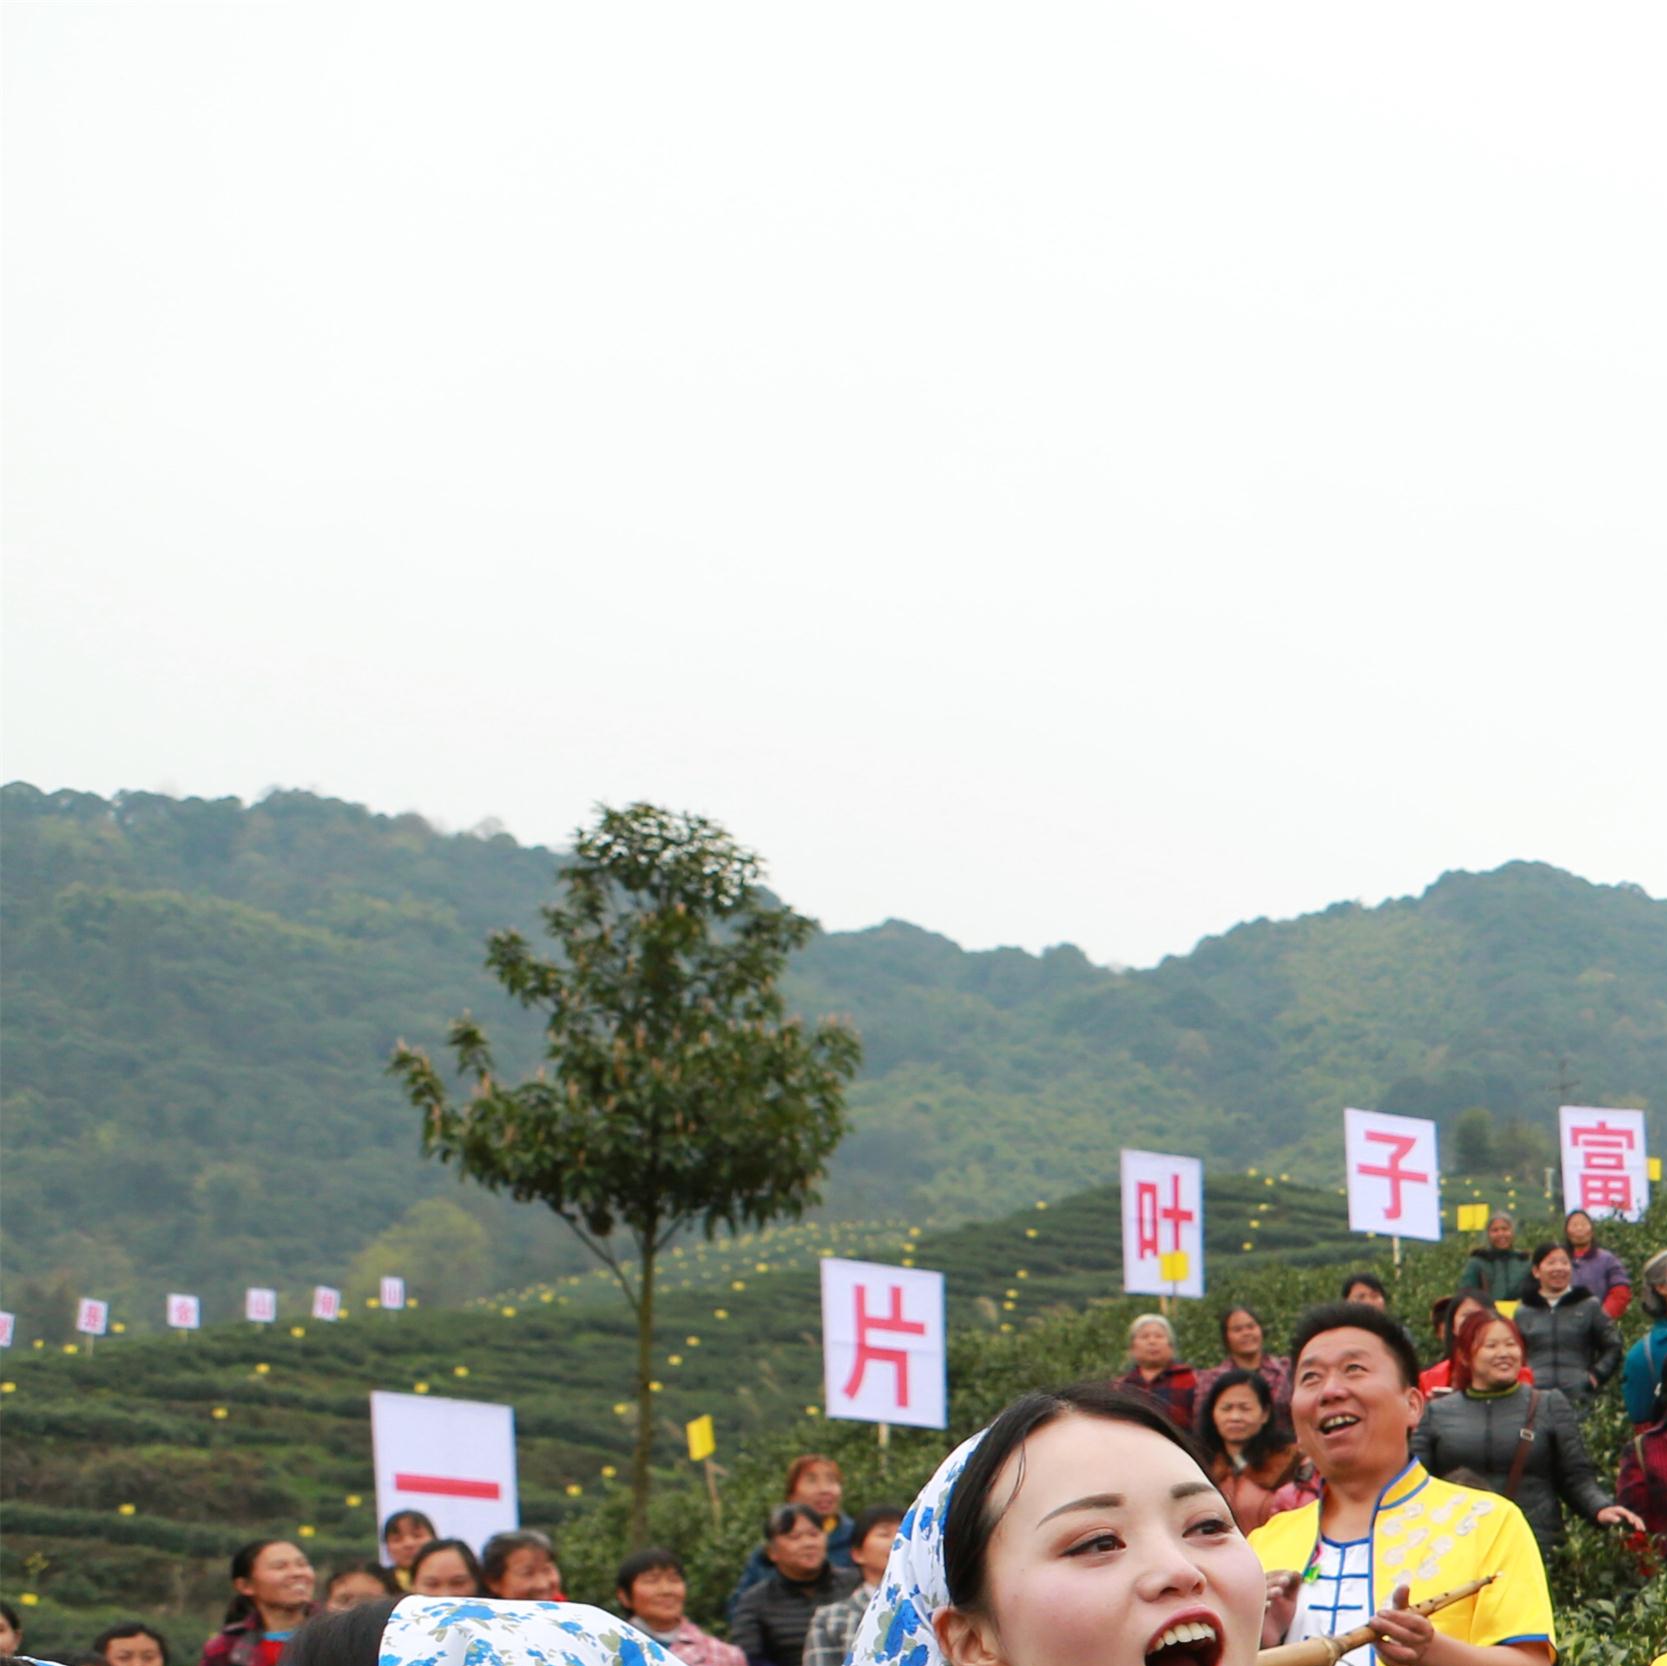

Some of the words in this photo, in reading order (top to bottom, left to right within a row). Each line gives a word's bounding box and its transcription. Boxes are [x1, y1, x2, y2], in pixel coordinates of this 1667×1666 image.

[1357, 1130, 1429, 1220] 子
[1571, 1121, 1635, 1211] 富
[1136, 1174, 1195, 1259] 叶
[843, 1284, 926, 1409] 片
[394, 1472, 501, 1501] 一
